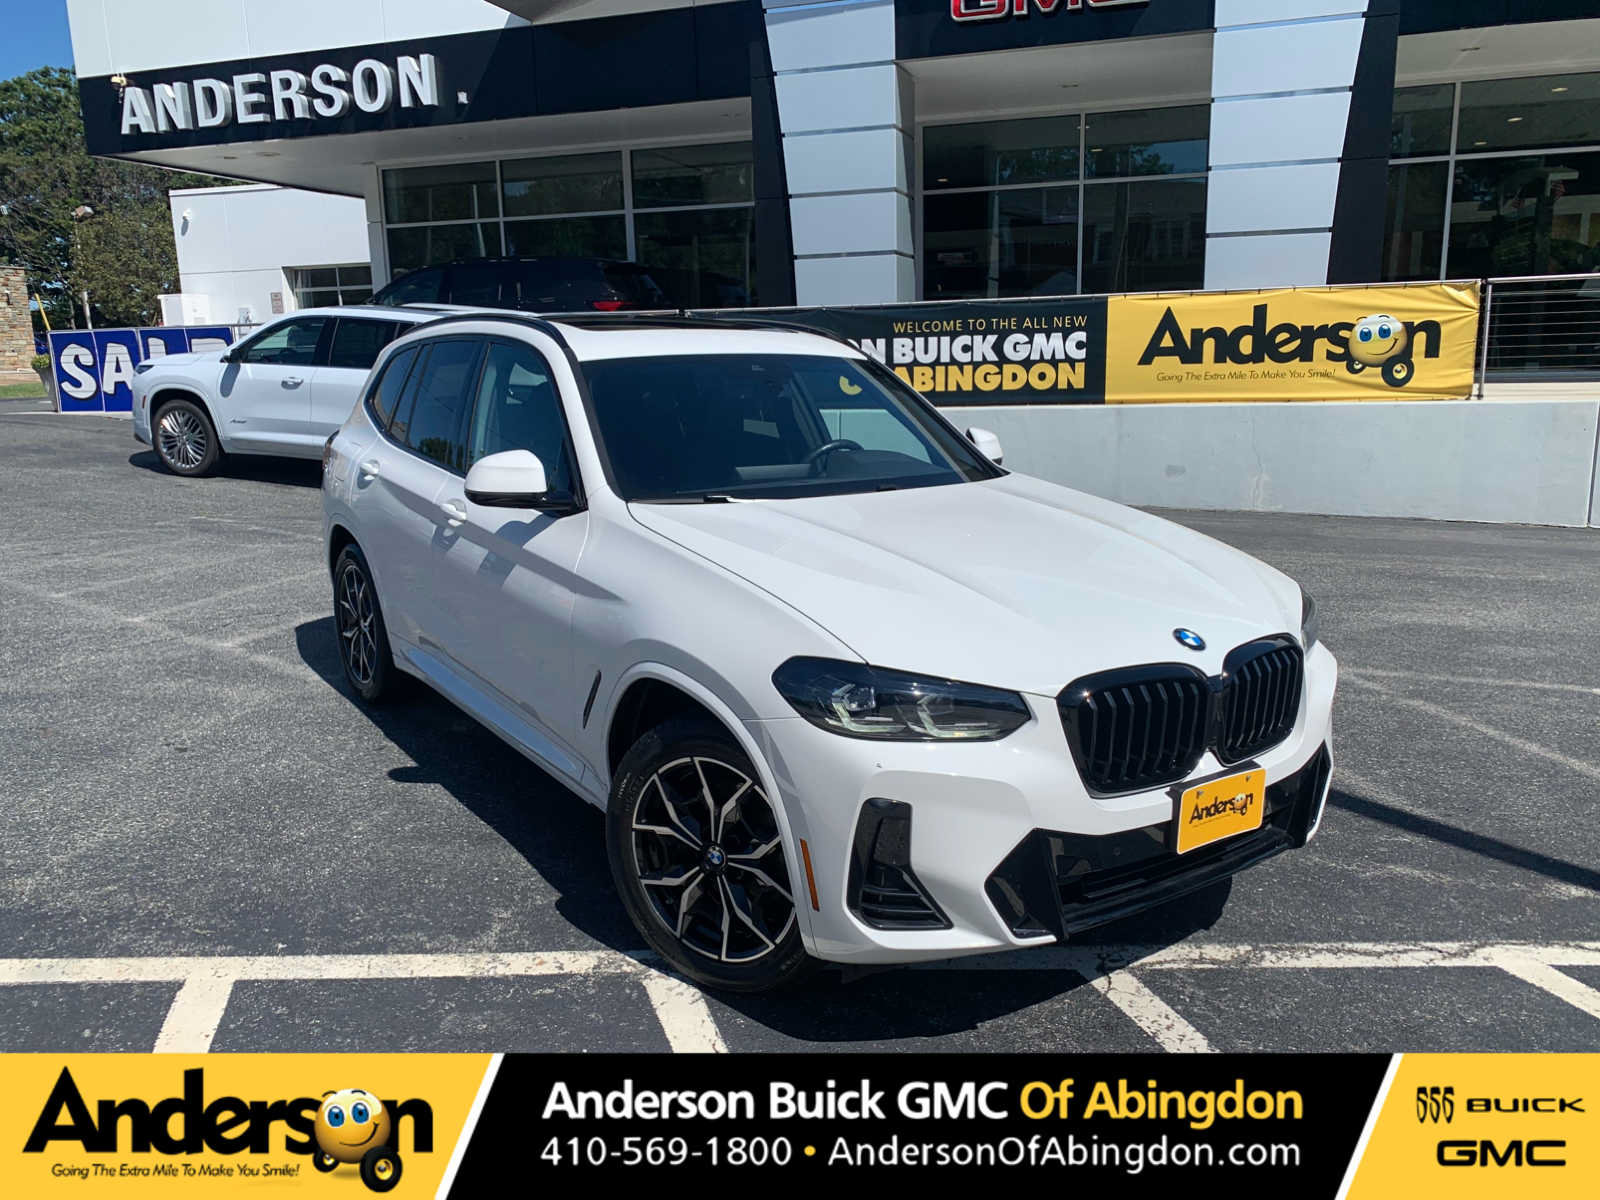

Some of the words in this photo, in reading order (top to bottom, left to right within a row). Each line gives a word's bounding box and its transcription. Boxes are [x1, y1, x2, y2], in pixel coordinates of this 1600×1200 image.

[121, 53, 439, 135] ANDERSON
[893, 319, 963, 334] WELCOME
[968, 318, 986, 331] TO
[991, 317, 1017, 330] THE
[1022, 316, 1049, 329] ALL
[1053, 315, 1088, 328] NEW
[892, 334, 999, 365] BUICK
[1003, 331, 1087, 362] GMC
[60, 337, 228, 400] SA
[1156, 372, 1183, 382] Going
[1186, 371, 1201, 381] The
[1203, 371, 1226, 381] Extra
[1227, 371, 1247, 380] Mile
[1249, 370, 1259, 379] To
[1260, 370, 1287, 380] Make
[1289, 369, 1306, 379] You
[1308, 368, 1336, 379] Smile!
